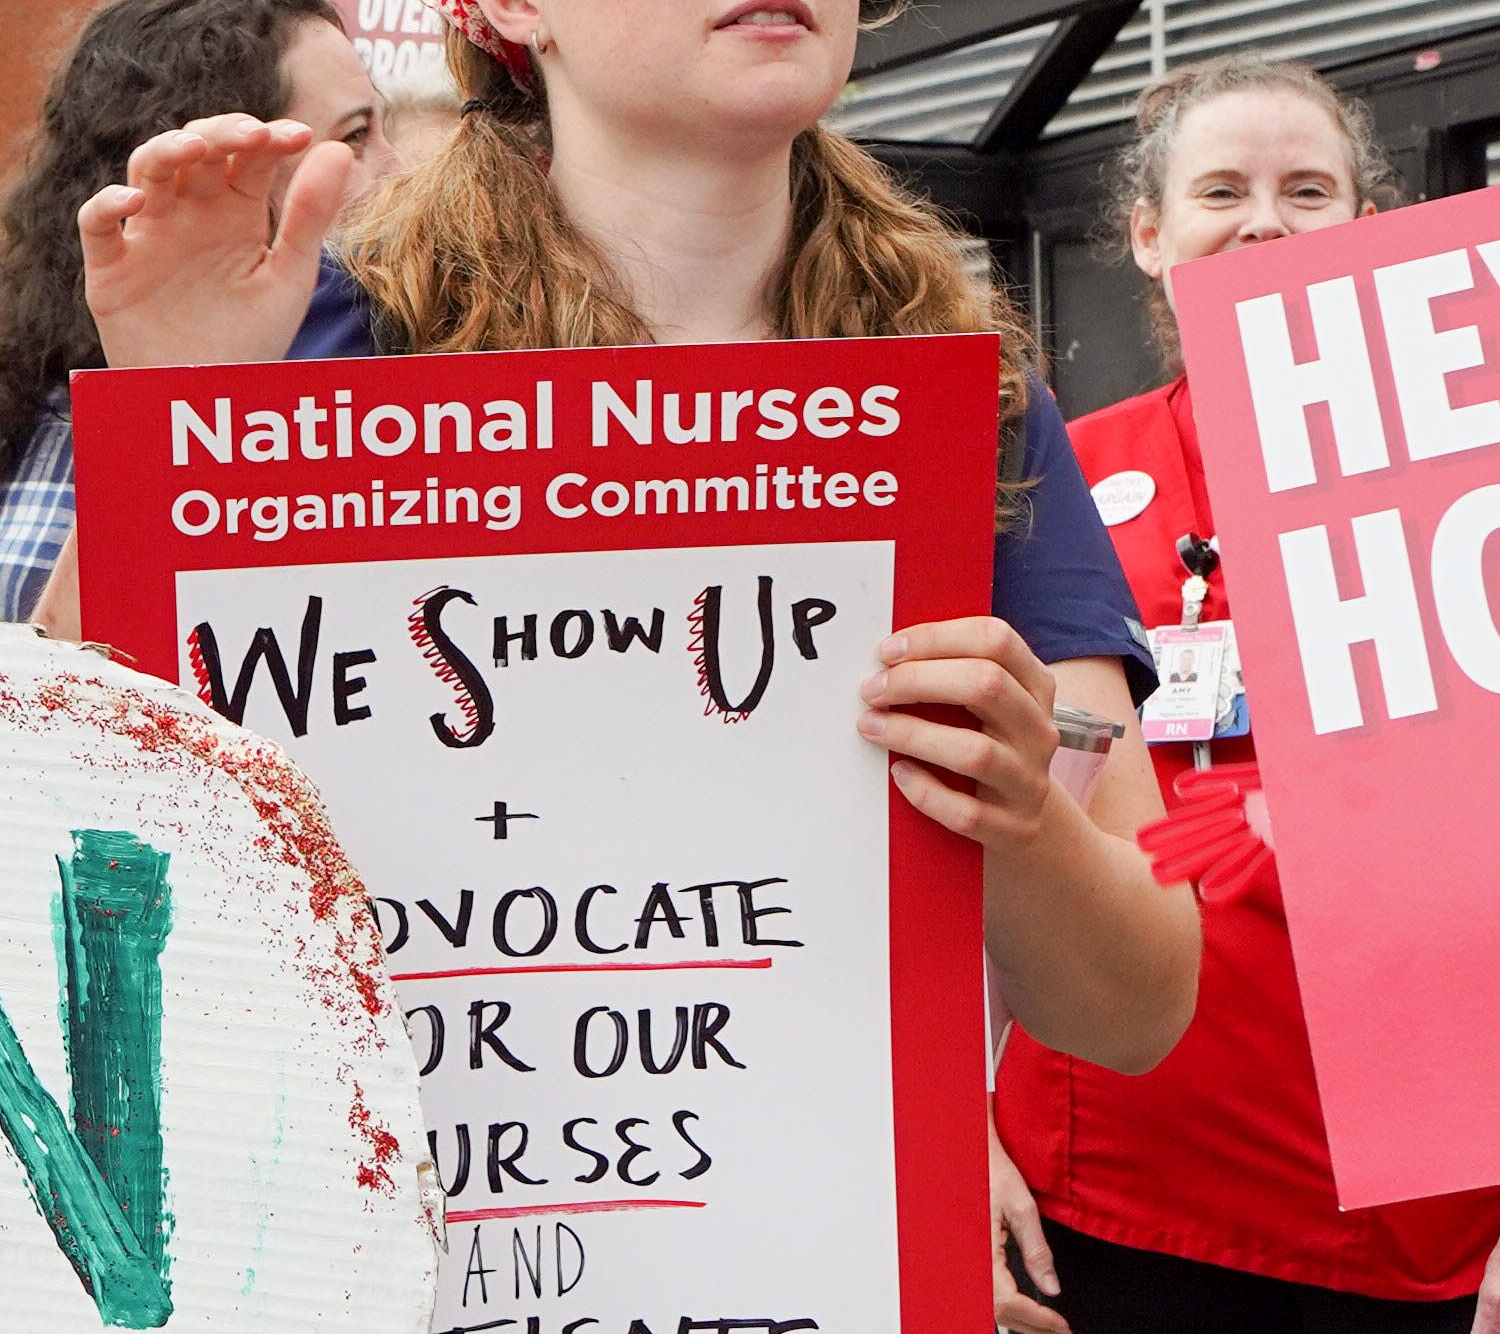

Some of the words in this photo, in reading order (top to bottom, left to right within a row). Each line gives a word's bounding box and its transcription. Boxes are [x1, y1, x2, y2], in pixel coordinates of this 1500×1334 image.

[171, 381, 552, 465] National
[593, 380, 899, 446] Nurses
[172, 478, 520, 541] Organizing
[546, 465, 897, 518] Committee
[1165, 722, 1188, 736] RN
[372, 878, 804, 957] DVOCATE
[412, 1000, 536, 1076] OR
[574, 1003, 746, 1078] OUR
[431, 1111, 711, 1197] URSES
[463, 1223, 584, 1307] AND
